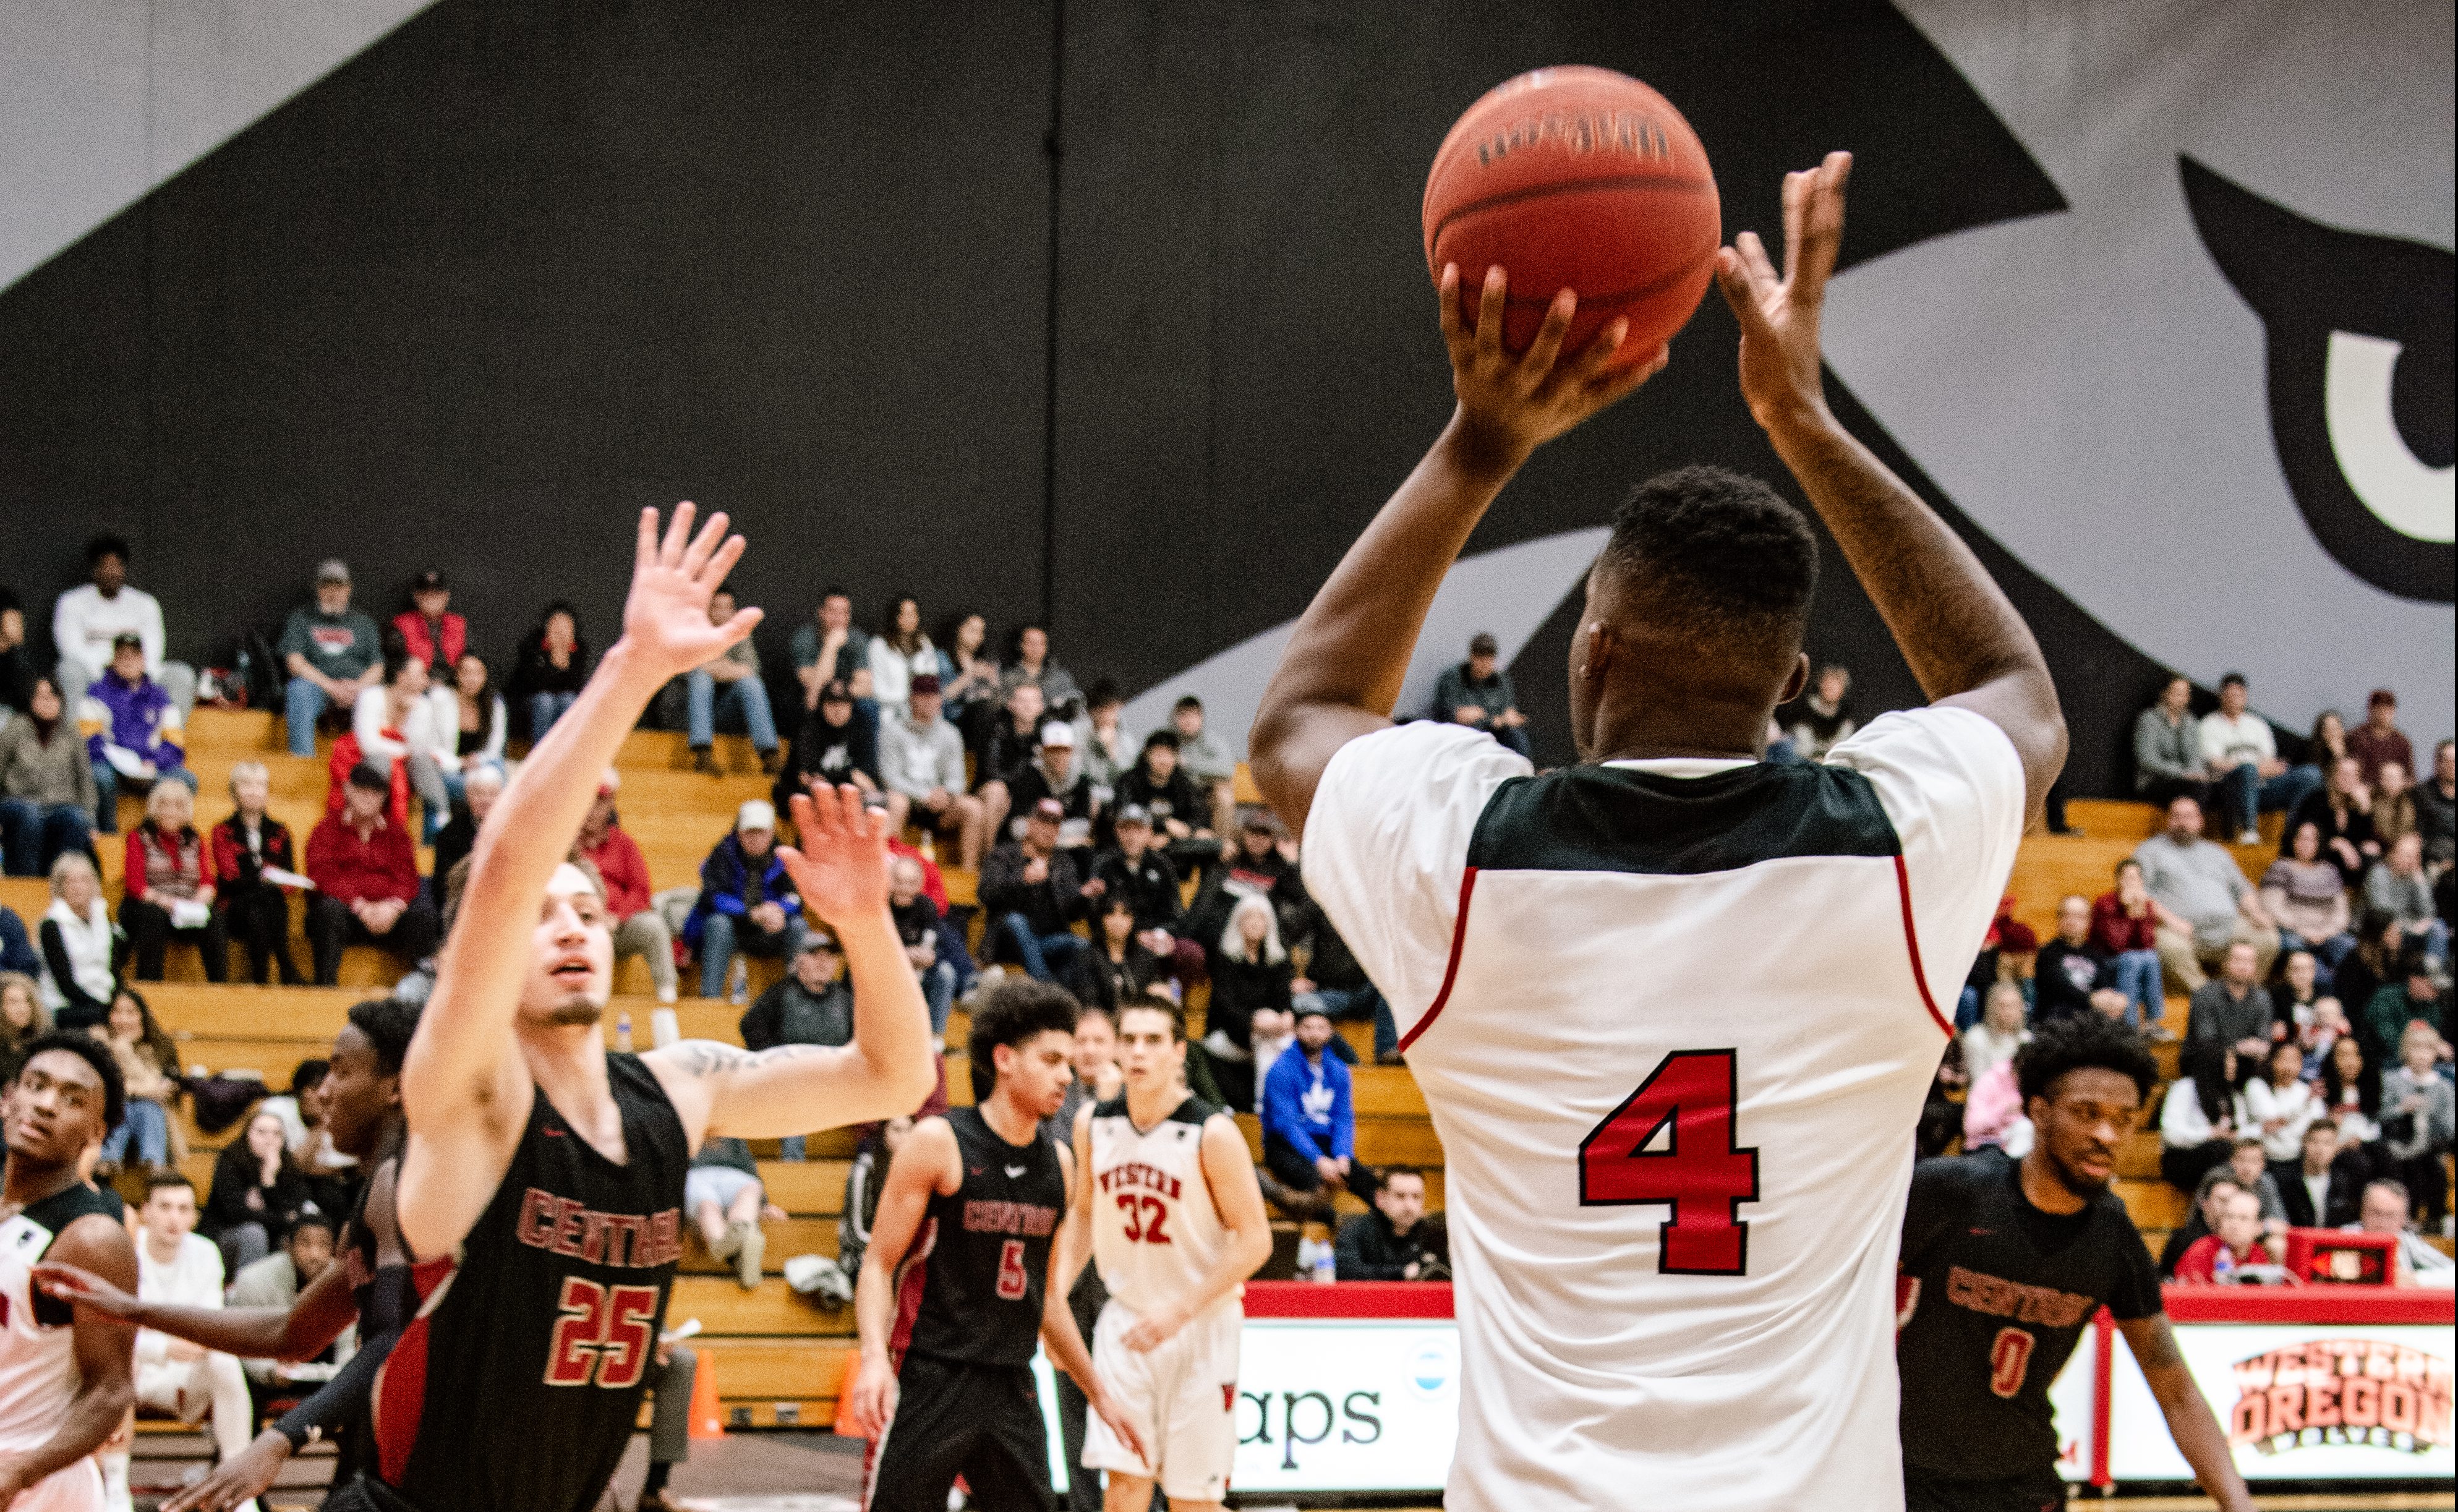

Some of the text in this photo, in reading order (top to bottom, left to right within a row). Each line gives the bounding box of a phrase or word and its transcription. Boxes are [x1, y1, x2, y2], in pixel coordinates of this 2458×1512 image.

[1099, 1161, 1182, 1200] WESTERN
[1579, 1048, 1759, 1275] 4
[1116, 1194, 1171, 1244] 32
[996, 1239, 1027, 1300] 5
[542, 1275, 660, 1388] 25
[1989, 1326, 2036, 1399] 0
[2232, 1338, 2455, 1398] WESTERN
[2228, 1377, 2454, 1448] OREGON
[2271, 1425, 2413, 1452] WOLVES
